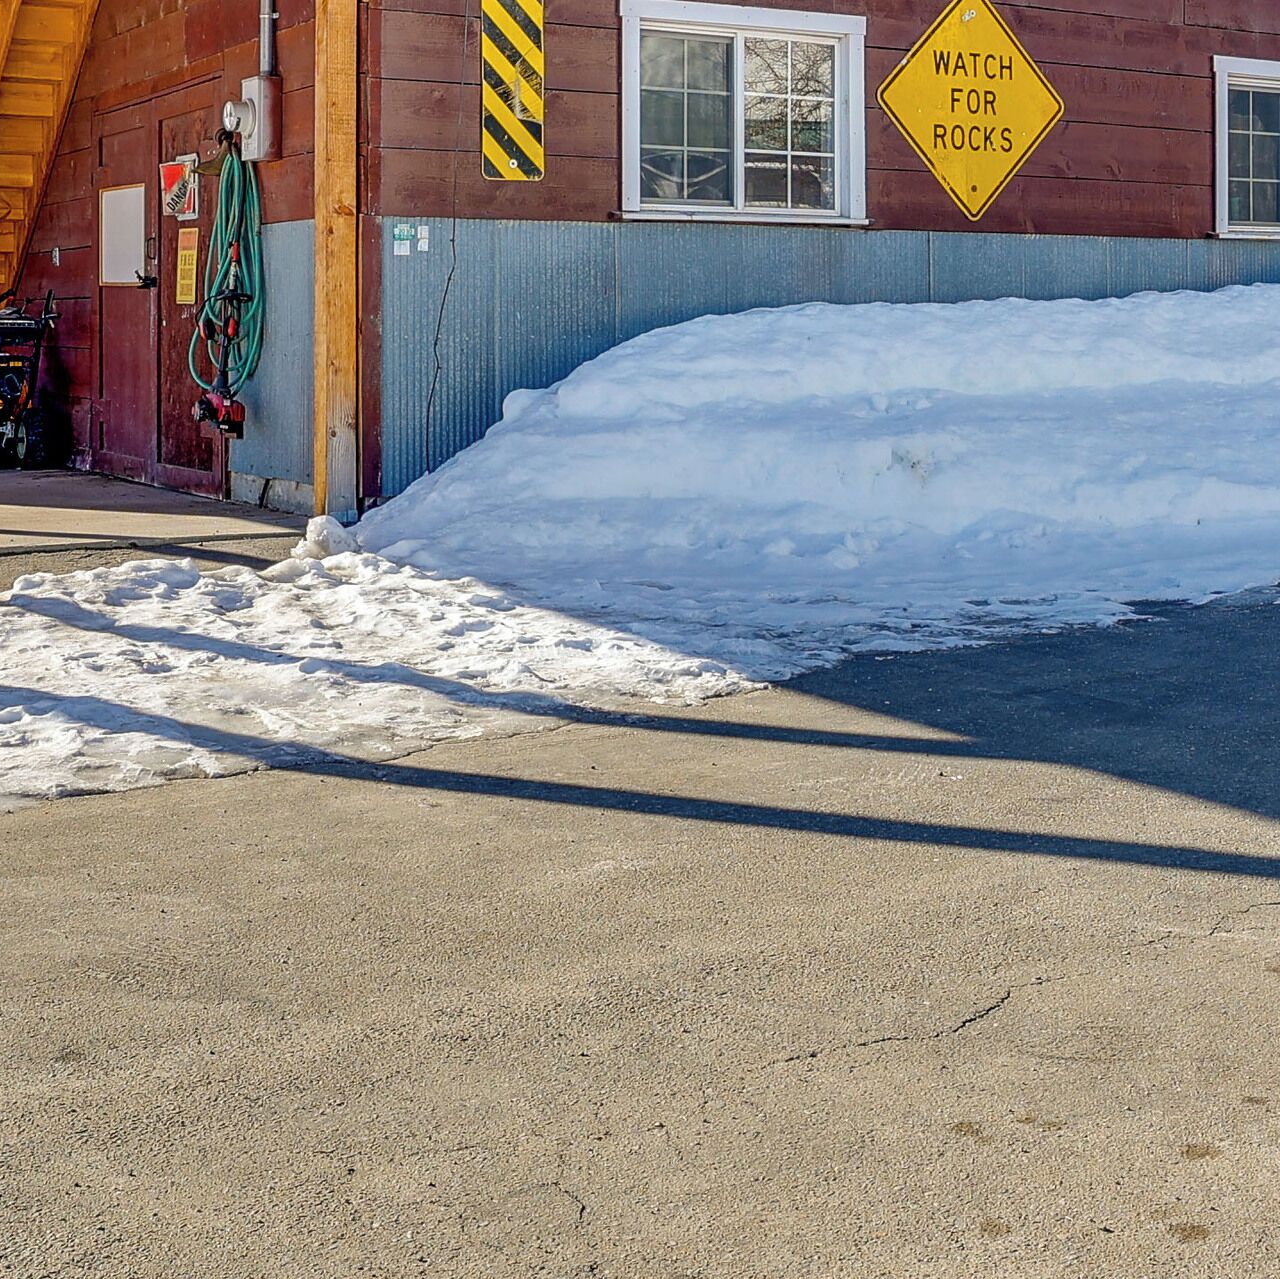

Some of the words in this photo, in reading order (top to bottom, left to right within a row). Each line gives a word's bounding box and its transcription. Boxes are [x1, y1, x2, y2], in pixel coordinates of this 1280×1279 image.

[933, 50, 1012, 80] WATCH
[951, 88, 996, 115] FOR
[933, 124, 1012, 152] ROCKS
